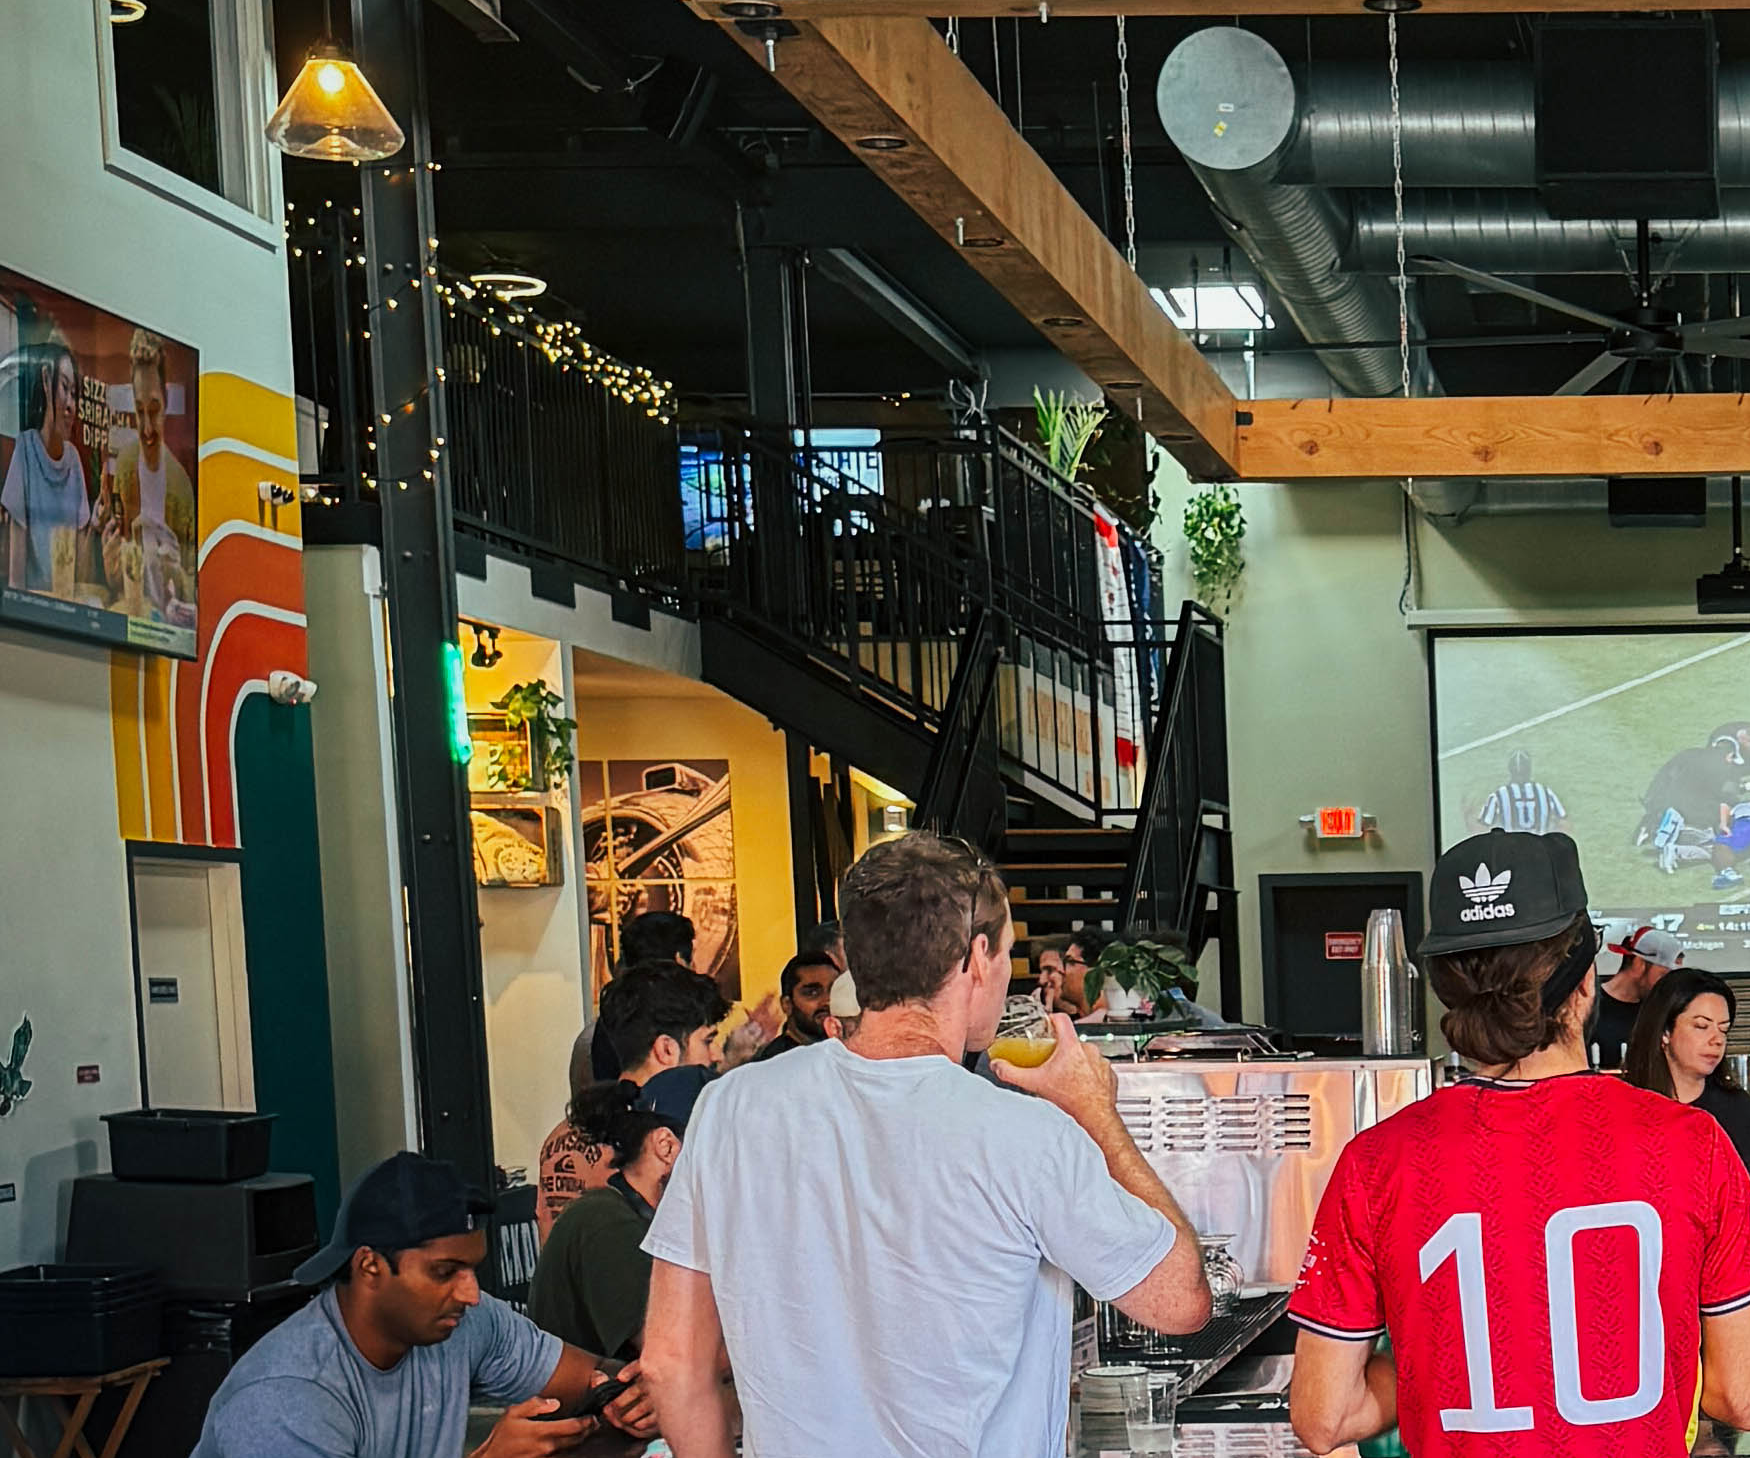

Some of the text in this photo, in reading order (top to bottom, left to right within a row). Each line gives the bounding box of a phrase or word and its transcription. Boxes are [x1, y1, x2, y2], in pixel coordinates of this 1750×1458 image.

[83, 375, 106, 403] SIZZ
[1460, 902, 1516, 922] adidas
[1650, 913, 1685, 932] 17
[1682, 940, 1725, 951] Michigan
[1417, 1199, 1665, 1435] 10
